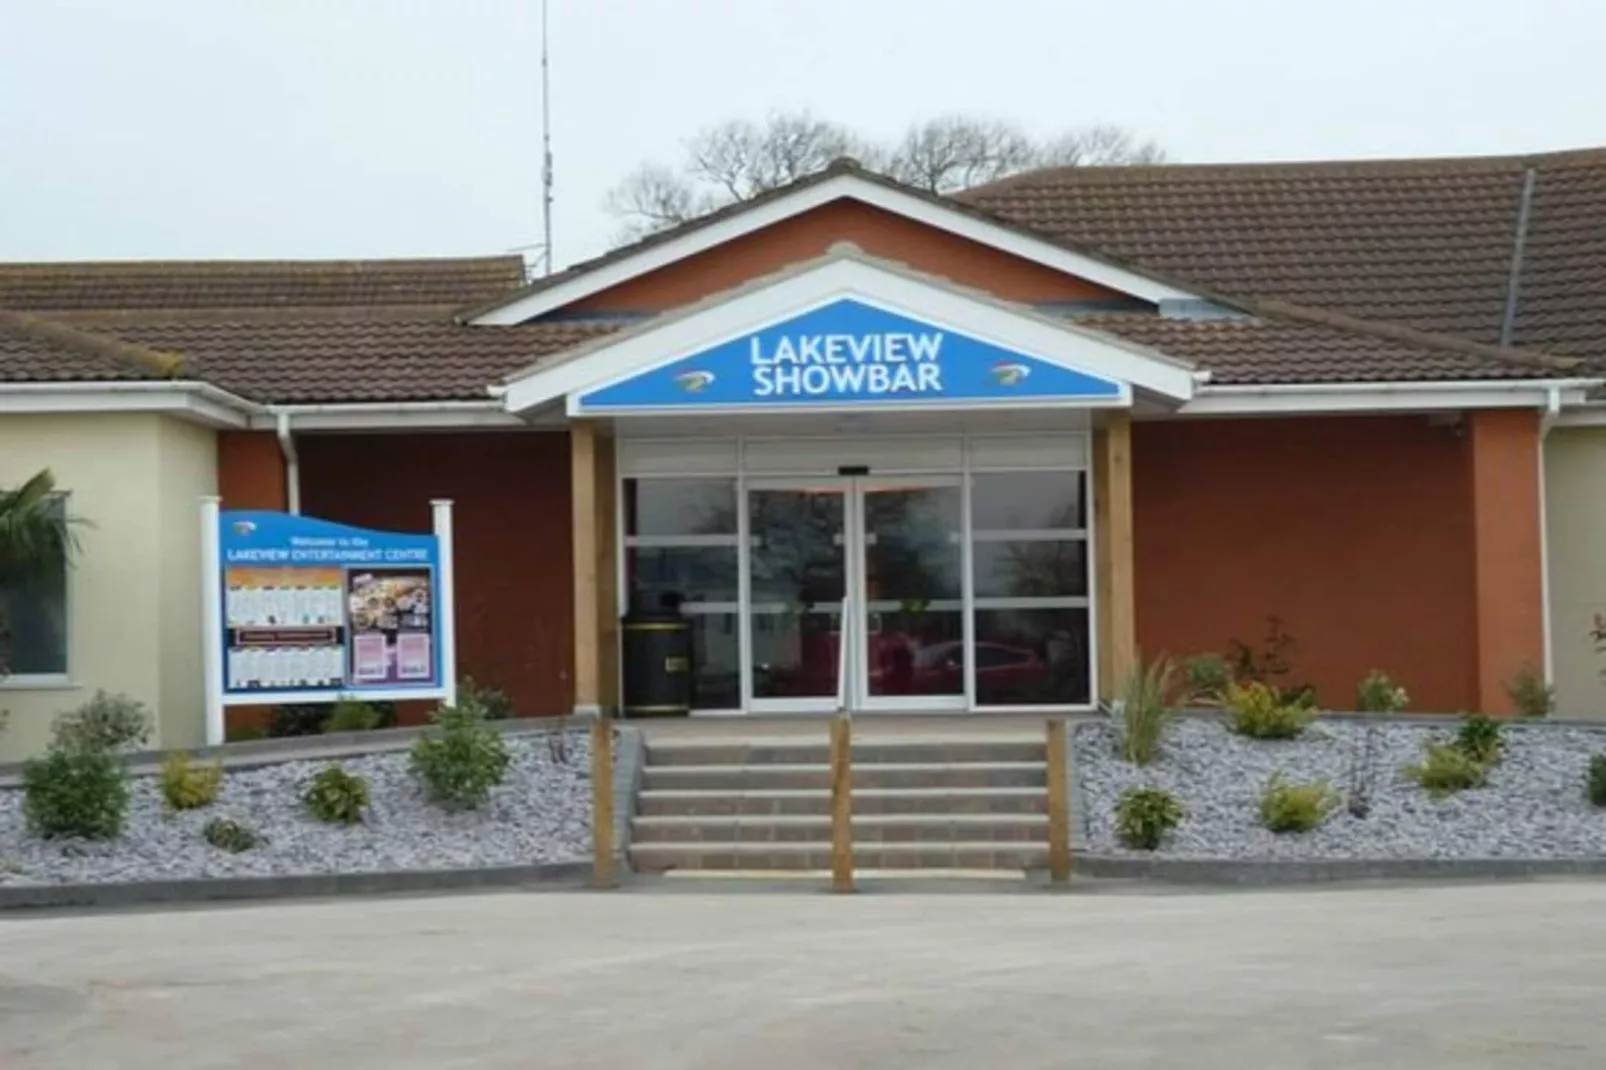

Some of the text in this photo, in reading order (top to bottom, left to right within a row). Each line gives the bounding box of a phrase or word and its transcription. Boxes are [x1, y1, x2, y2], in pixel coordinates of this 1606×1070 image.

[751, 333, 943, 364] LAKEVIEW
[753, 363, 943, 395] SHOWBAR
[227, 548, 428, 561] LAKEVIEW ENTERTAINMENT CENTRE
